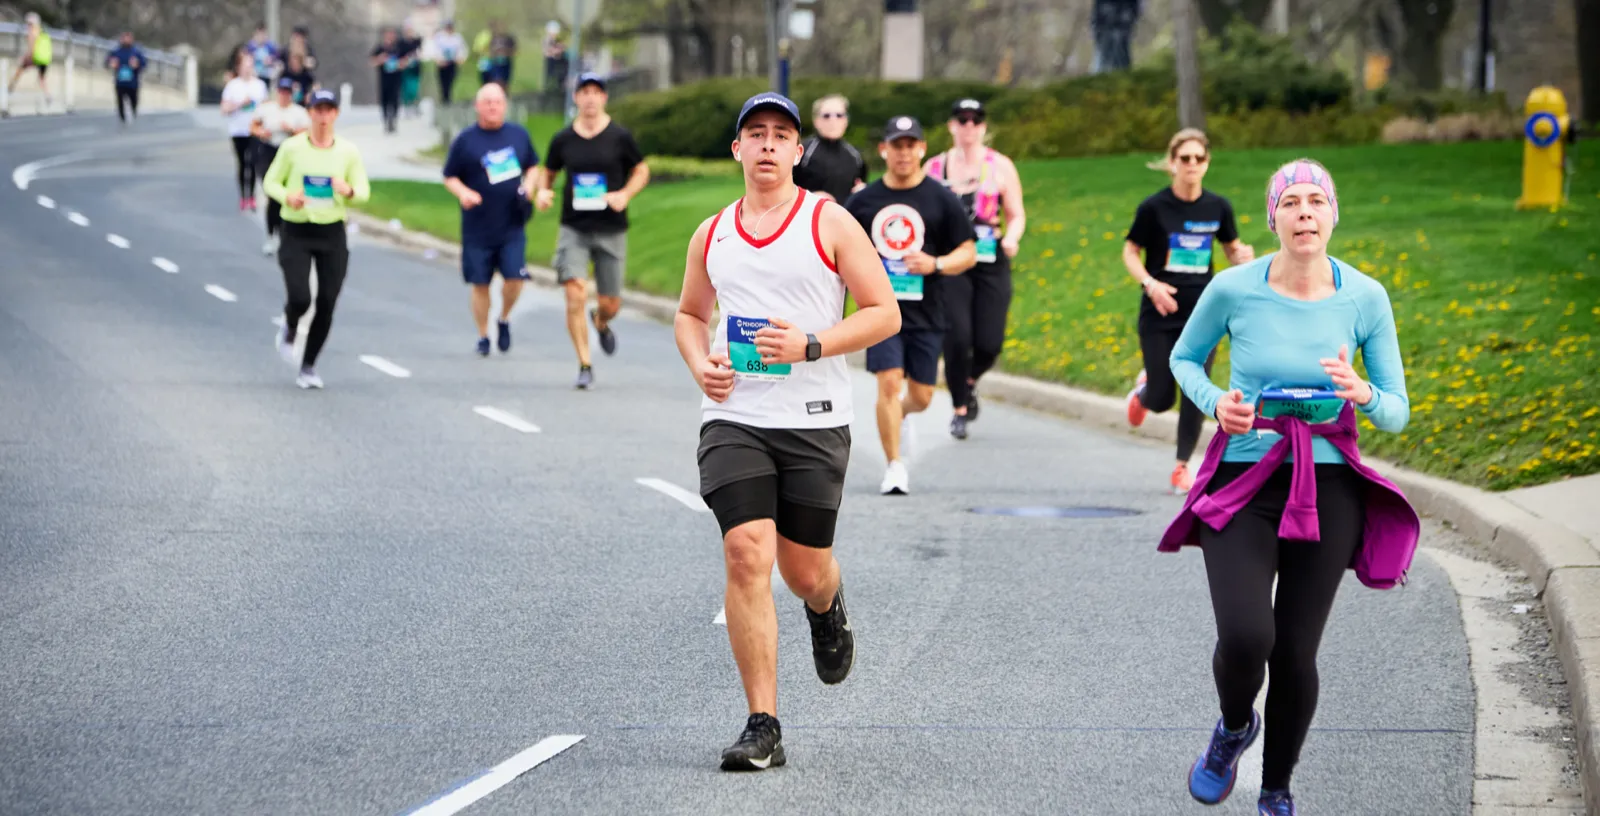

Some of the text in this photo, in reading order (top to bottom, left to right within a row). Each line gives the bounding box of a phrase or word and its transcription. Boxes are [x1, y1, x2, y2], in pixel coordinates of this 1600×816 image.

[754, 97, 789, 109] bumrun
[746, 360, 769, 372] 638
[1281, 401, 1322, 412] HOLLY
